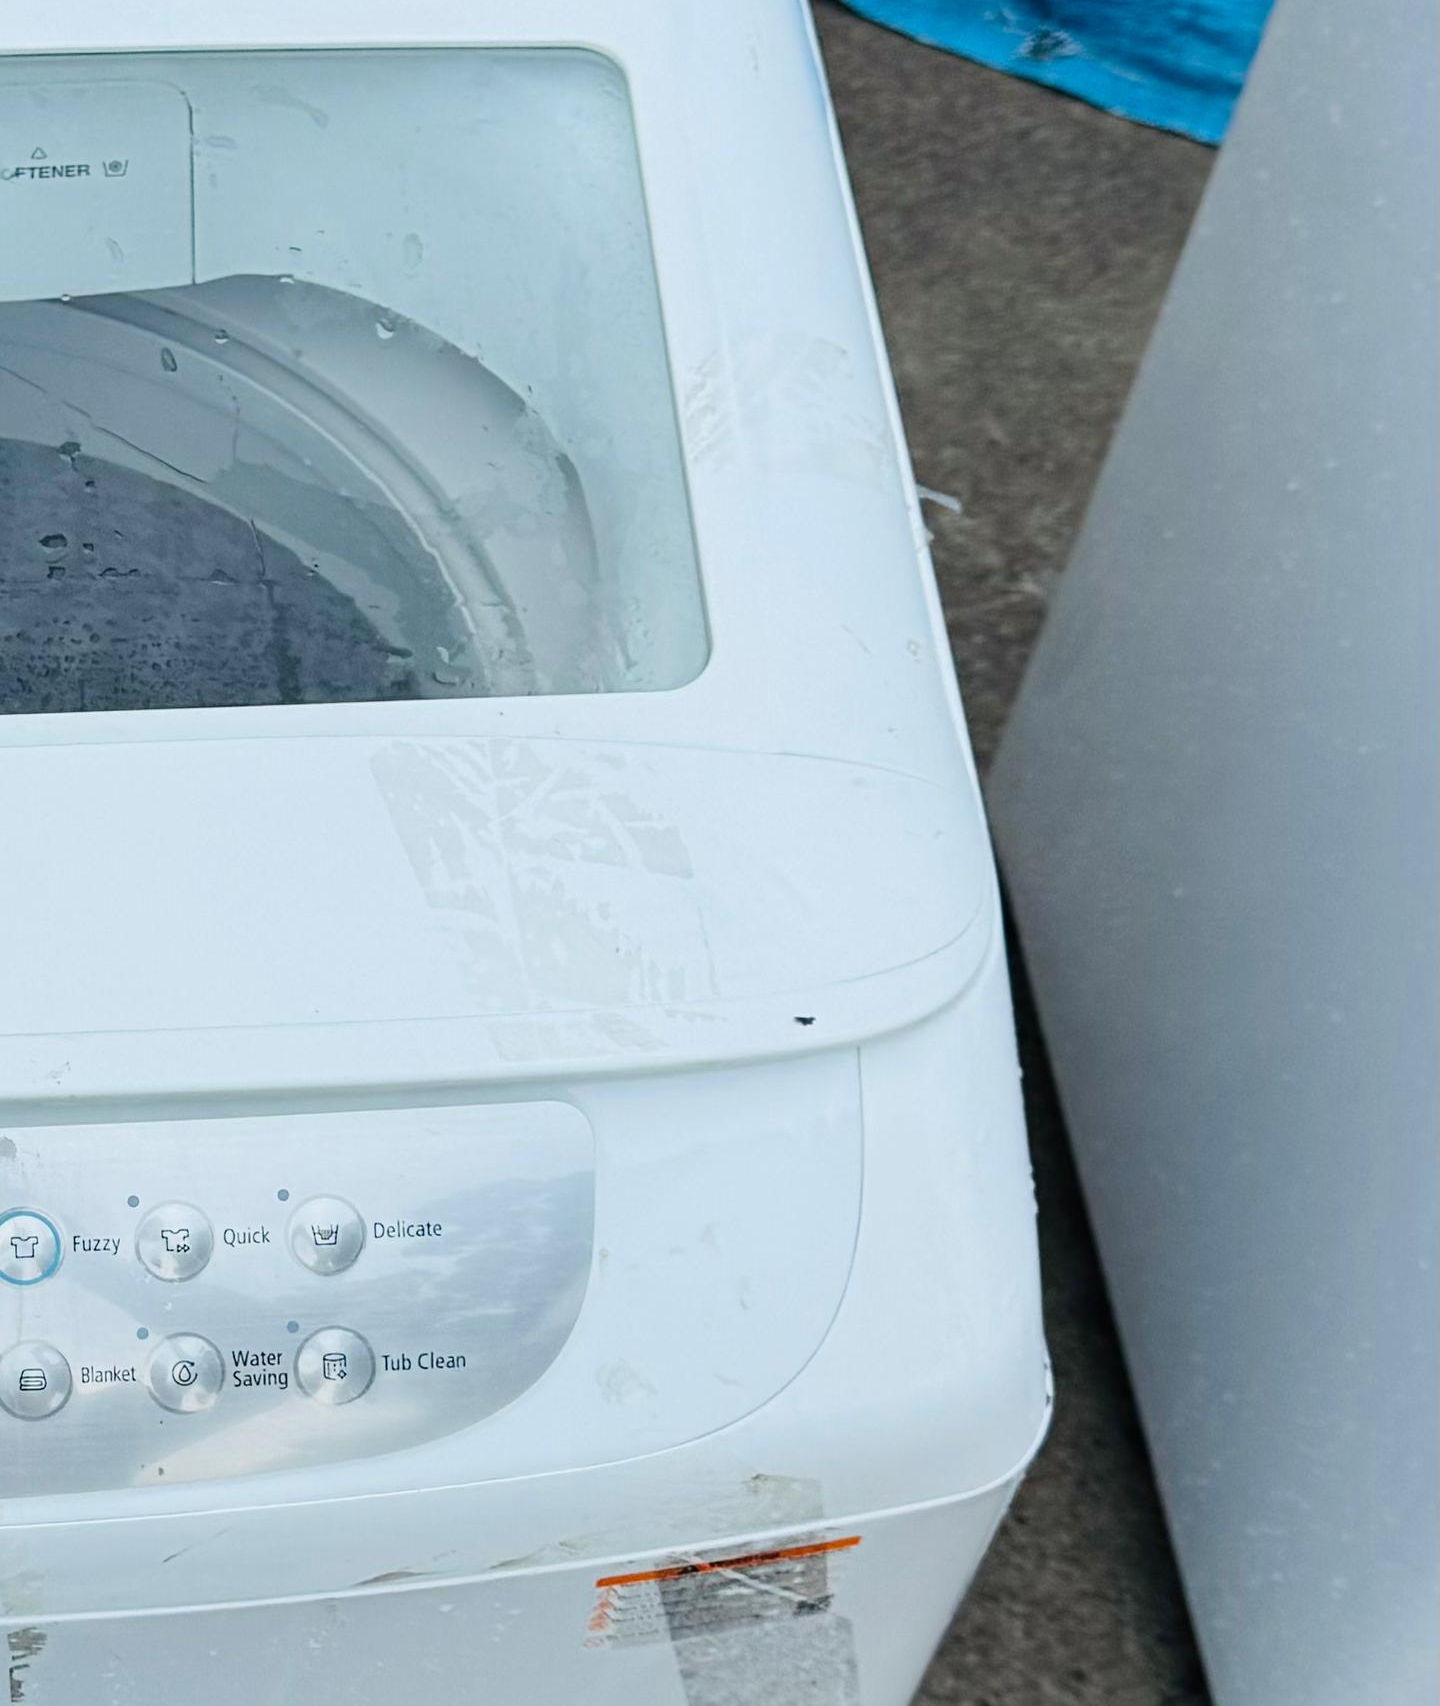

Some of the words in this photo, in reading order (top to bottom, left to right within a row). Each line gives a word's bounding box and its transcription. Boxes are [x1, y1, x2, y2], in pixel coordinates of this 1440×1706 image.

[223, 1225, 271, 1246] Quick
[373, 1221, 443, 1239] Delicate
[72, 1235, 121, 1255] Fuzzy
[232, 1349, 283, 1367] Water
[382, 1353, 412, 1372] Tub
[417, 1351, 467, 1370] Clean
[81, 1366, 137, 1384] Blanket
[233, 1369, 289, 1390] Saving
